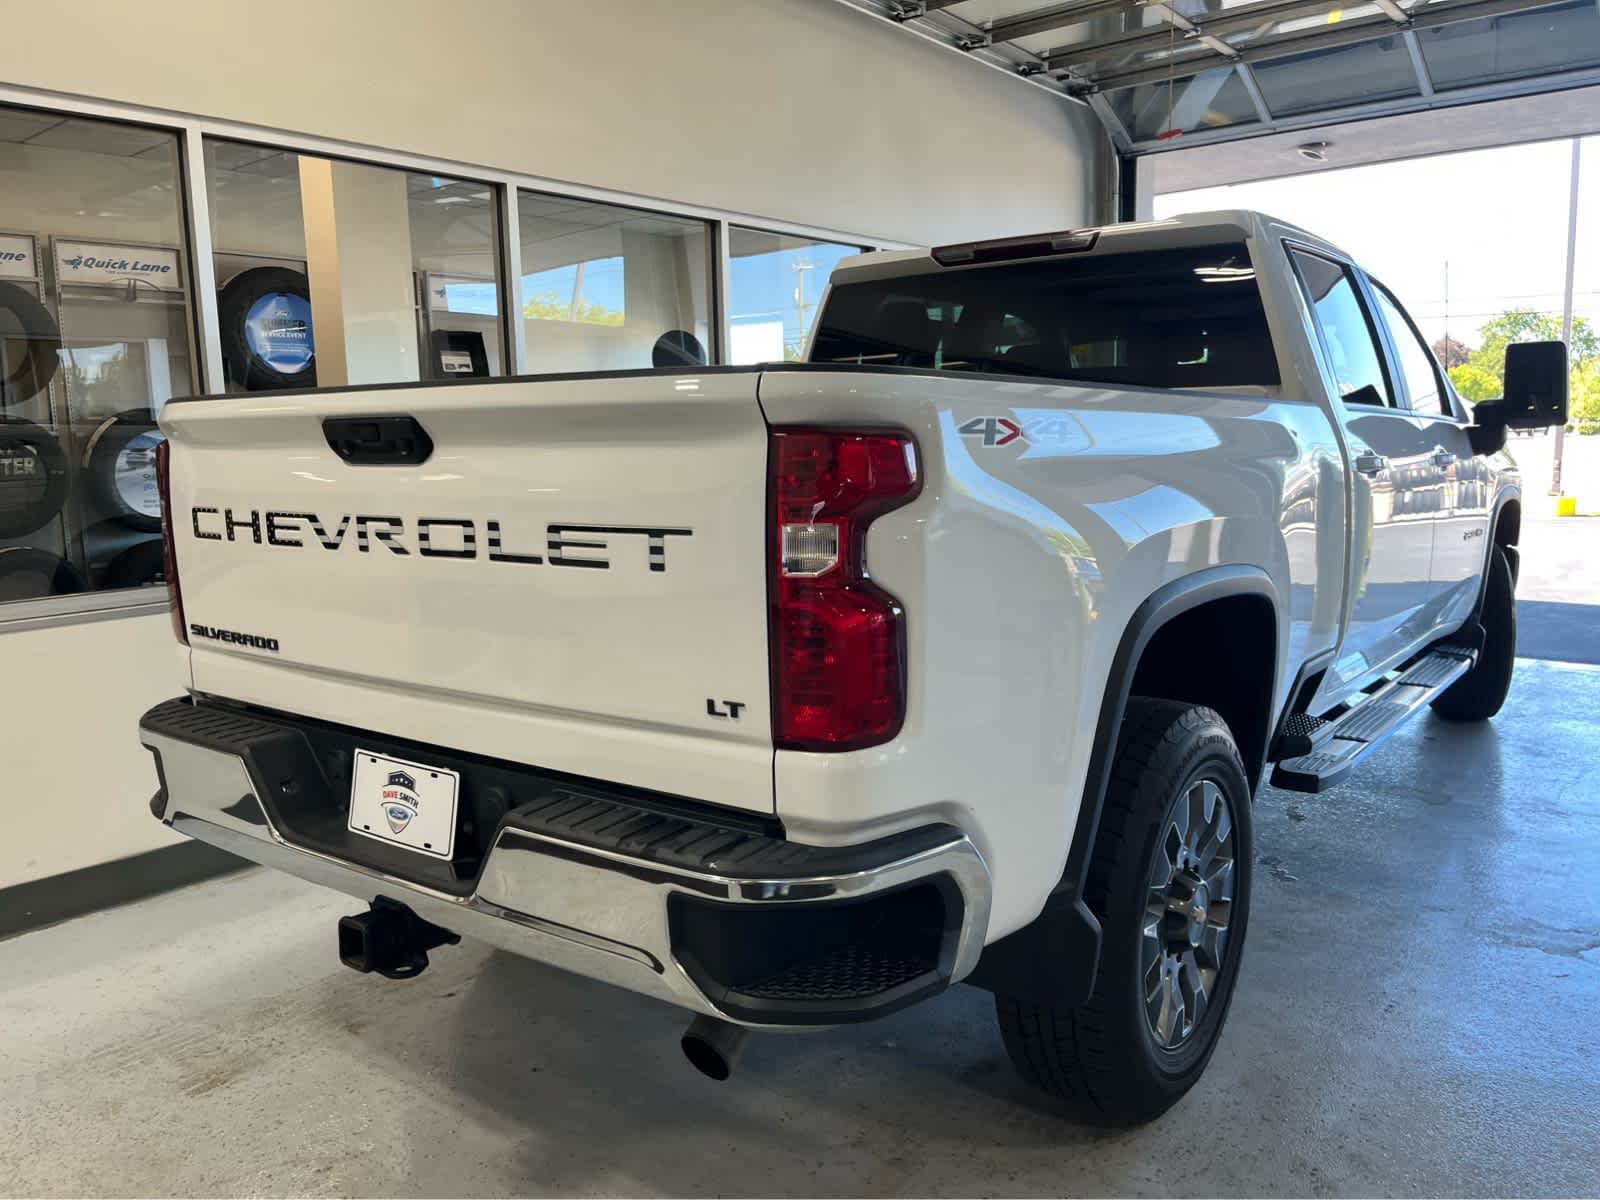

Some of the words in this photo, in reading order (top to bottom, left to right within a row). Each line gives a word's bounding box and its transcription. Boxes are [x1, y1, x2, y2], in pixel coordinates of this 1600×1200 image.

[83, 257, 129, 271] Quick
[131, 261, 171, 273] Lane
[191, 507, 693, 572] CHEVROLET
[190, 623, 280, 652] SILVERADO
[706, 698, 745, 719] LT
[382, 790, 399, 799] DAVE
[399, 792, 419, 809] SMITH
